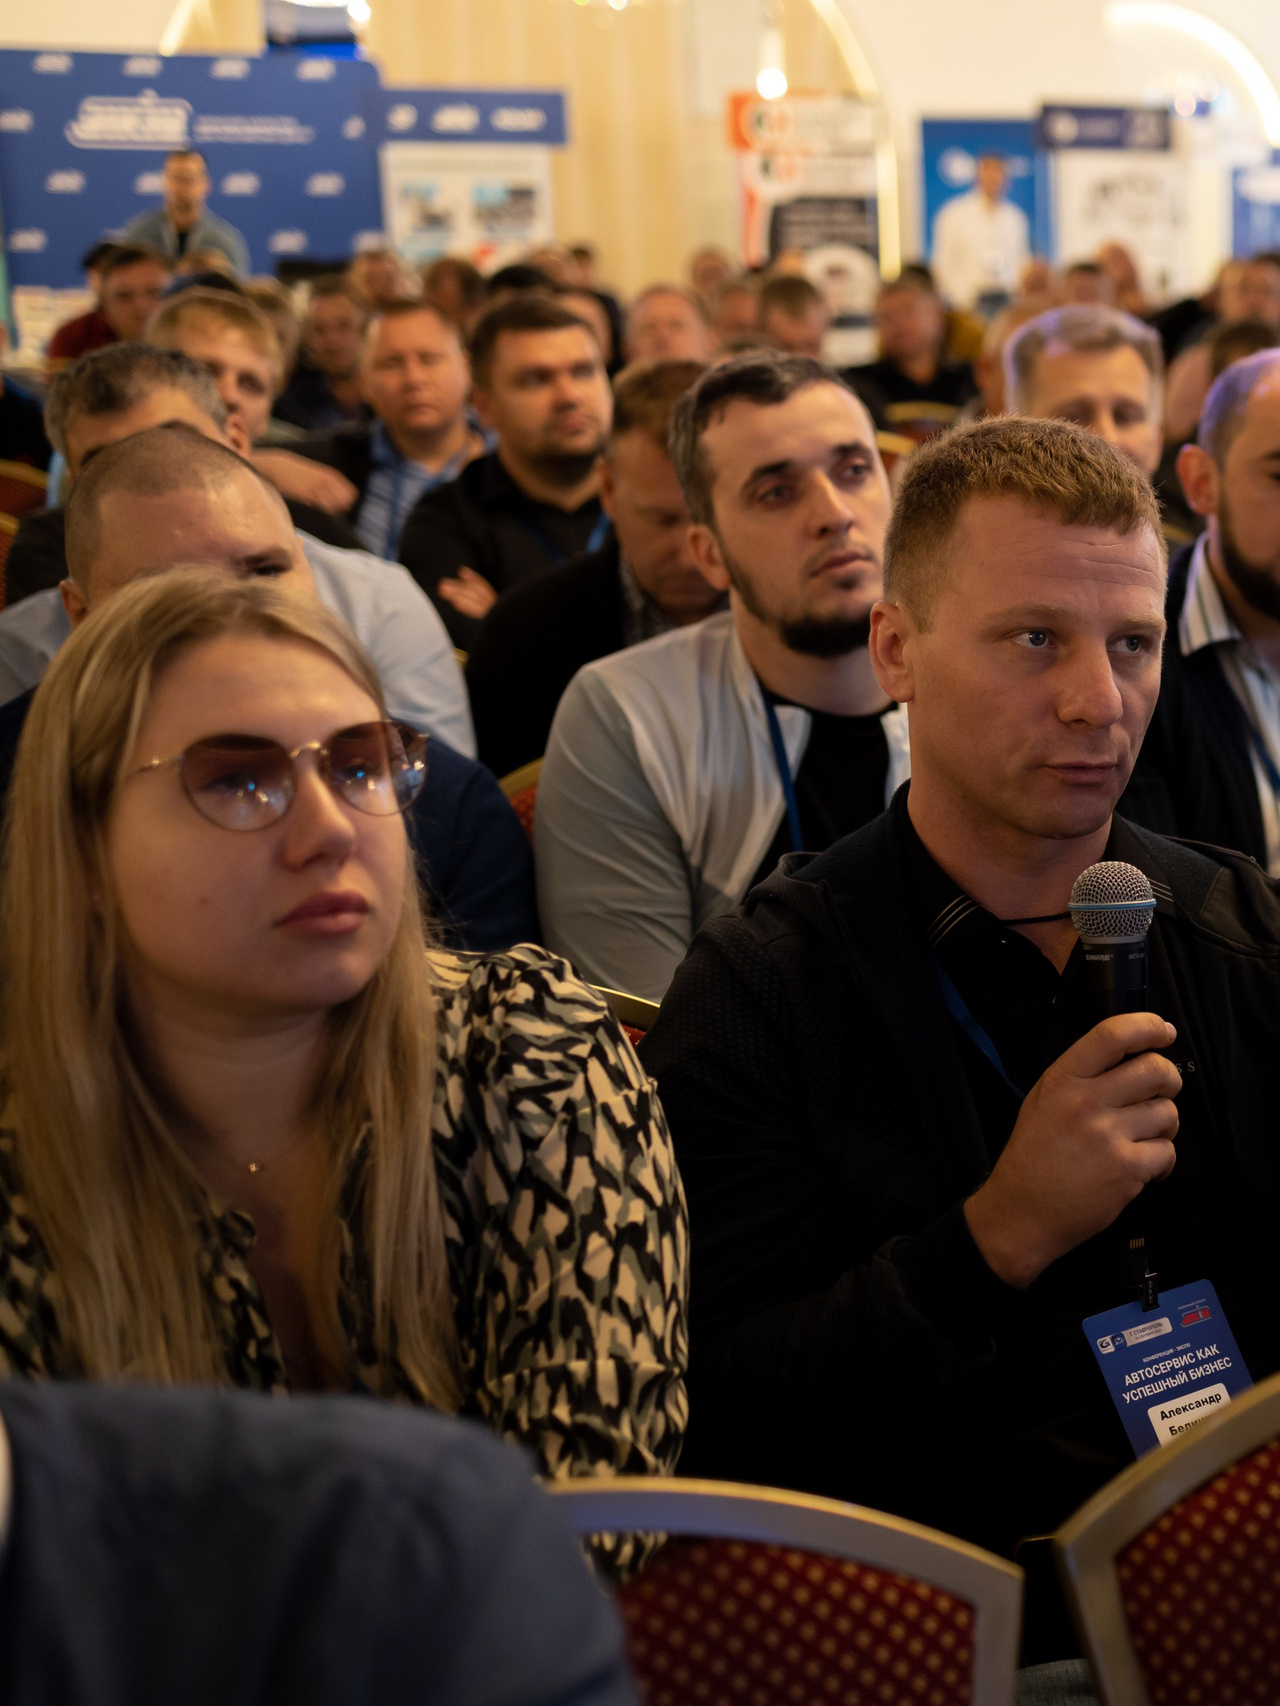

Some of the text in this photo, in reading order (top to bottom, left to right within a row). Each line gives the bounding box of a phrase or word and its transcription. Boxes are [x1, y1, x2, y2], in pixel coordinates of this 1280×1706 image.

[1122, 1357, 1232, 1404] УСПЕШНЫЙ БИЗНЕС
[1124, 1343, 1220, 1386] АВТОСЕРВИС КАК
[1160, 1393, 1222, 1421] Александр
